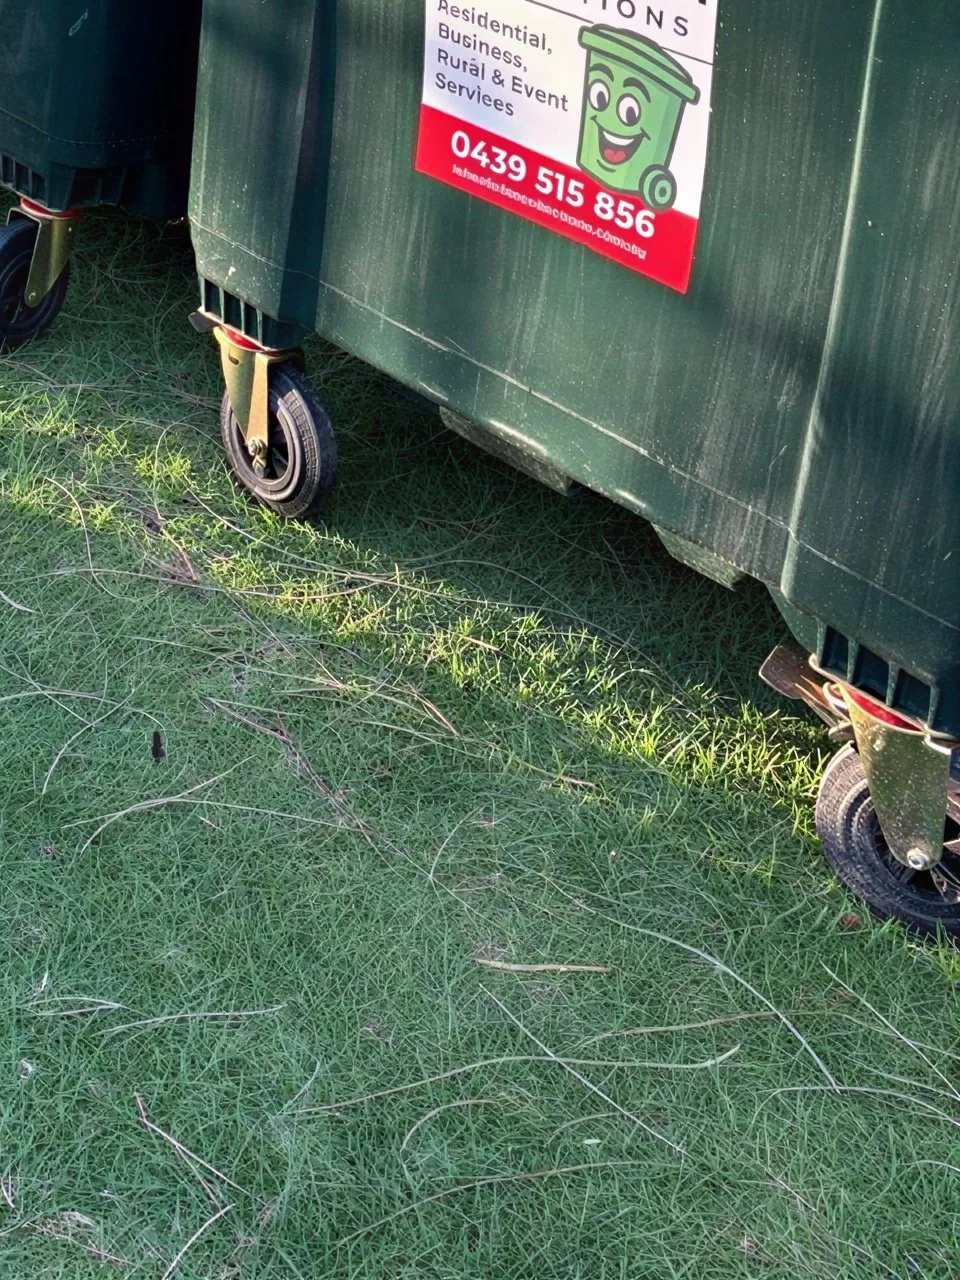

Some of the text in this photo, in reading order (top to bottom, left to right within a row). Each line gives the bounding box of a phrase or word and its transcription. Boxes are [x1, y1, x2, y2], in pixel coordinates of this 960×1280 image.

[438, 22, 527, 72] Business,
[491, 68, 505, 87] &
[511, 75, 568, 112] Event
[451, 130, 527, 182] 0439
[534, 166, 585, 208] 515
[593, 191, 656, 238] 856
